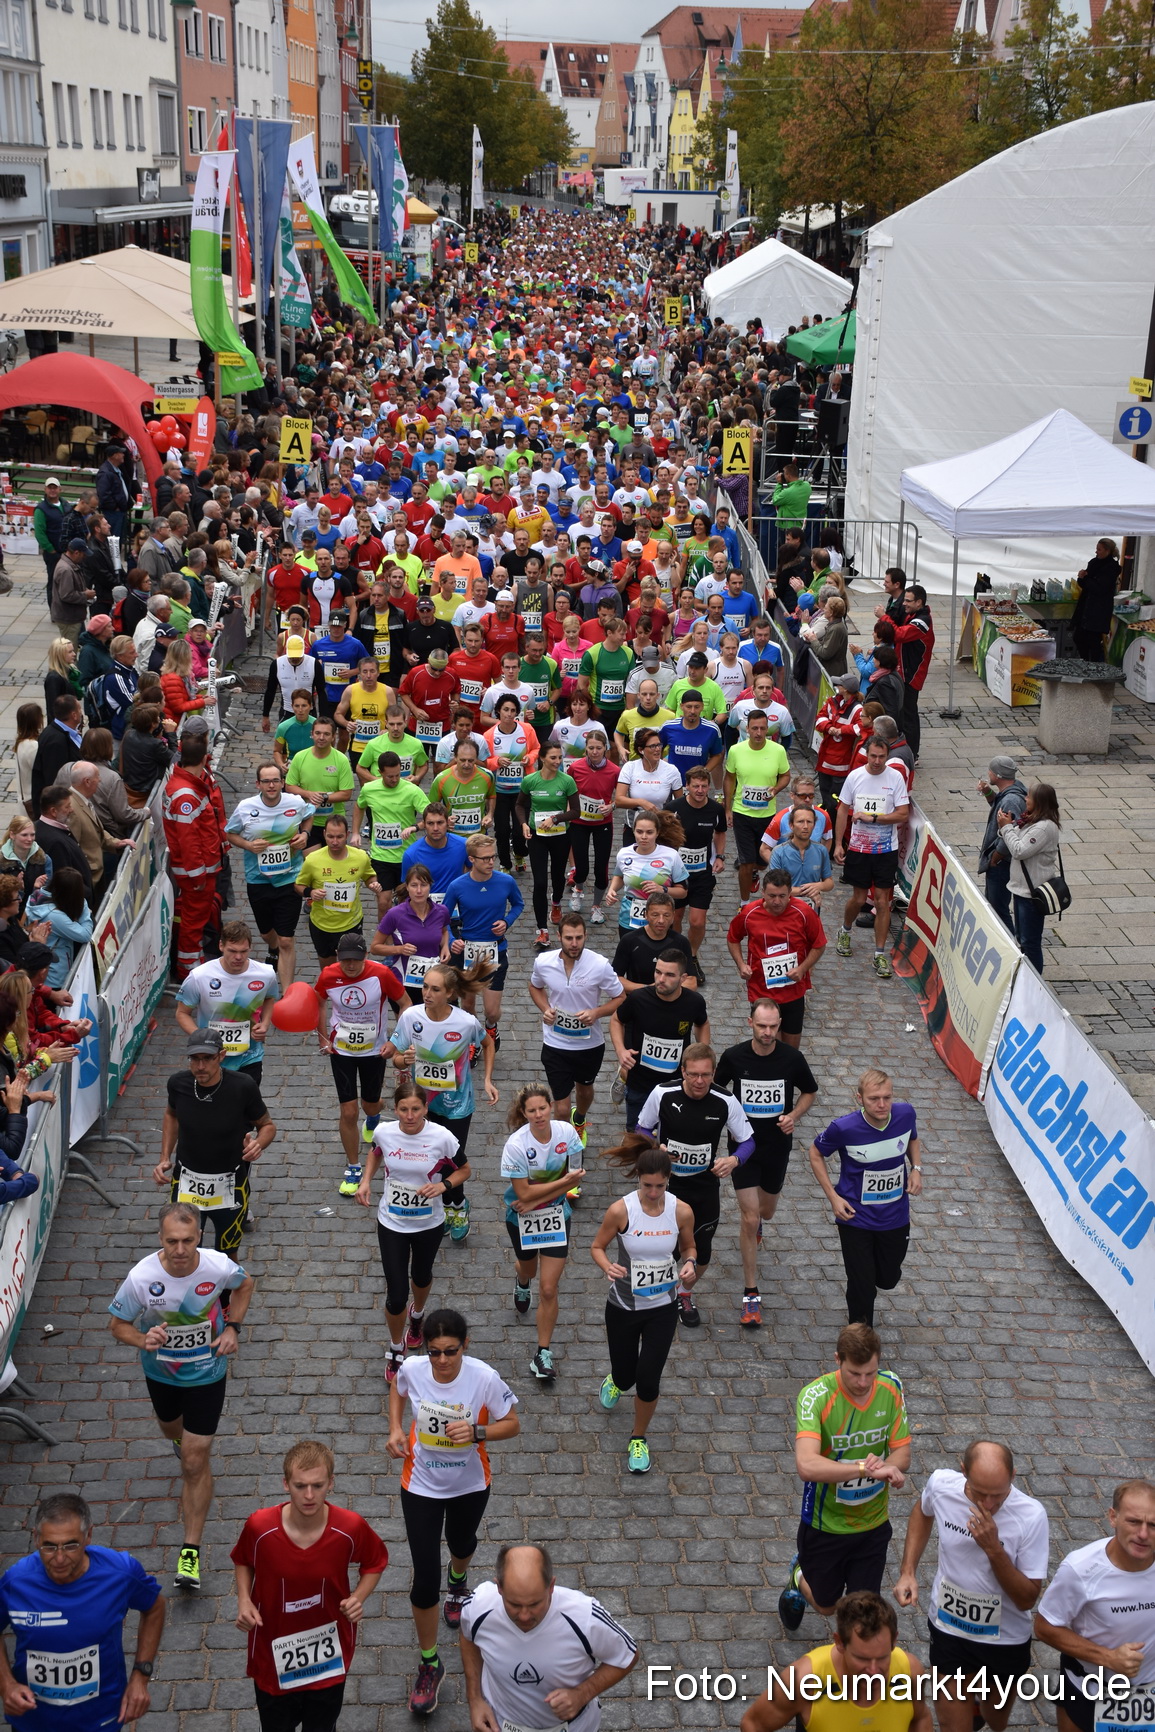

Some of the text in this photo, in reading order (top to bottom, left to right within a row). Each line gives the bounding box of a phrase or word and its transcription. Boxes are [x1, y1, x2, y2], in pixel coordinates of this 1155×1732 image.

[468, 249, 475, 258] C
[21, 307, 104, 320] Neumarkter
[669, 306, 679, 319] B
[0, 314, 114, 329] Lammsbräu
[157, 385, 195, 395] Klostergasse
[285, 418, 309, 431] Block
[726, 430, 750, 439] Block
[286, 432, 304, 455] A
[729, 442, 746, 464] A
[524, 616, 541, 625] 2176
[460, 684, 480, 696] 3022
[604, 685, 622, 695] 2368
[357, 725, 379, 735] 2403
[418, 725, 440, 737] 3055
[674, 744, 703, 754] HUBER
[499, 766, 522, 777] 2059
[448, 793, 485, 805] BOCK
[864, 801, 877, 812] 44
[456, 813, 480, 825] 2749
[376, 828, 400, 840] 2244
[261, 851, 289, 865] 2802
[681, 854, 705, 864] 2591
[333, 890, 348, 902] 84
[767, 960, 797, 978] 2317
[348, 1031, 365, 1044] 95
[645, 1036, 658, 1045] PARTL
[645, 1042, 679, 1061] 3074
[422, 1064, 449, 1080] 269
[745, 1089, 781, 1104] 2236
[757, 1105, 775, 1113] Andreas
[995, 1016, 1155, 1250] slackstar
[188, 1179, 215, 1197] 264
[867, 1174, 902, 1192] 2064
[191, 1196, 209, 1207] Georg
[535, 1210, 556, 1218] Neumarkt
[523, 1216, 562, 1235] 2125
[531, 1234, 556, 1243] Melanie
[643, 1229, 673, 1237] KLEBL
[649, 1261, 672, 1269] Neumarkt
[636, 1266, 675, 1287] 2174
[649, 1286, 663, 1294] Lisa
[177, 1325, 203, 1335] Neumarkt
[163, 1330, 207, 1350] 2233
[171, 1350, 198, 1358] Johann
[420, 1404, 466, 1422] PARTL Neumarkt
[435, 1438, 454, 1448] Jutta
[426, 1459, 467, 1470] SIEMENS
[853, 1487, 875, 1498] Arthur
[940, 1581, 990, 1606] PARTL Neumarkt
[295, 1602, 312, 1610] DEHN
[943, 1591, 996, 1624] 2507
[950, 1617, 984, 1635] Manfred
[274, 1631, 327, 1652] PARTL Neumarkt
[53, 1653, 87, 1666] Neumarkt
[281, 1635, 336, 1672] 2573
[34, 1660, 93, 1687] 3109
[293, 1665, 329, 1680] Matthias
[40, 1685, 75, 1698] Ernst
[1101, 1697, 1155, 1724] 2509
